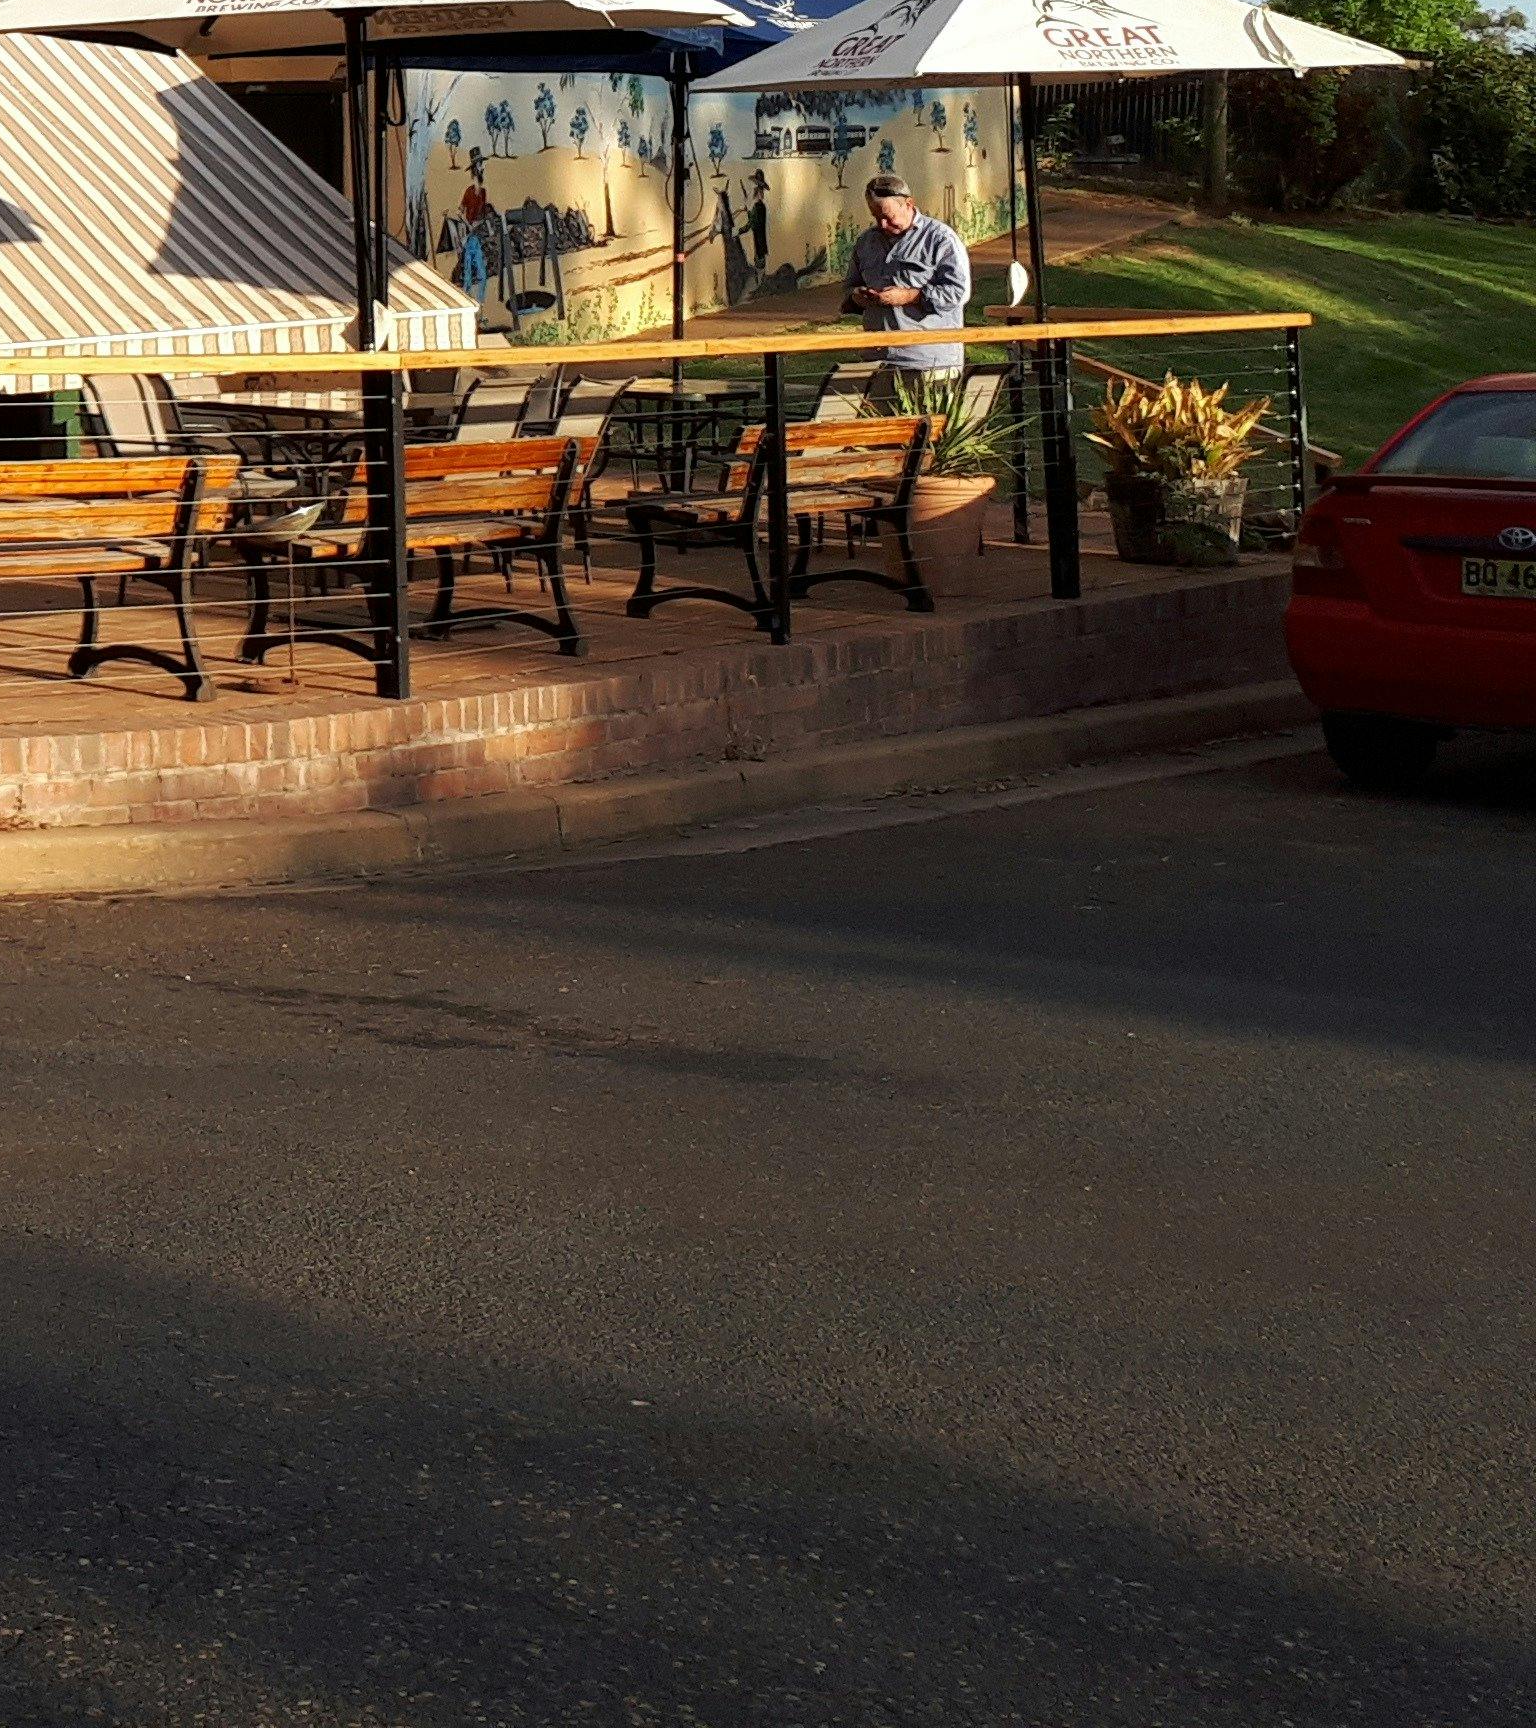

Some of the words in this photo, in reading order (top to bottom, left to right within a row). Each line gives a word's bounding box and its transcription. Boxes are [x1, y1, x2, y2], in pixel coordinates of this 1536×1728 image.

[832, 34, 906, 56] GREAT
[1043, 25, 1163, 47] GREAT
[1058, 46, 1178, 60] NORTHERN
